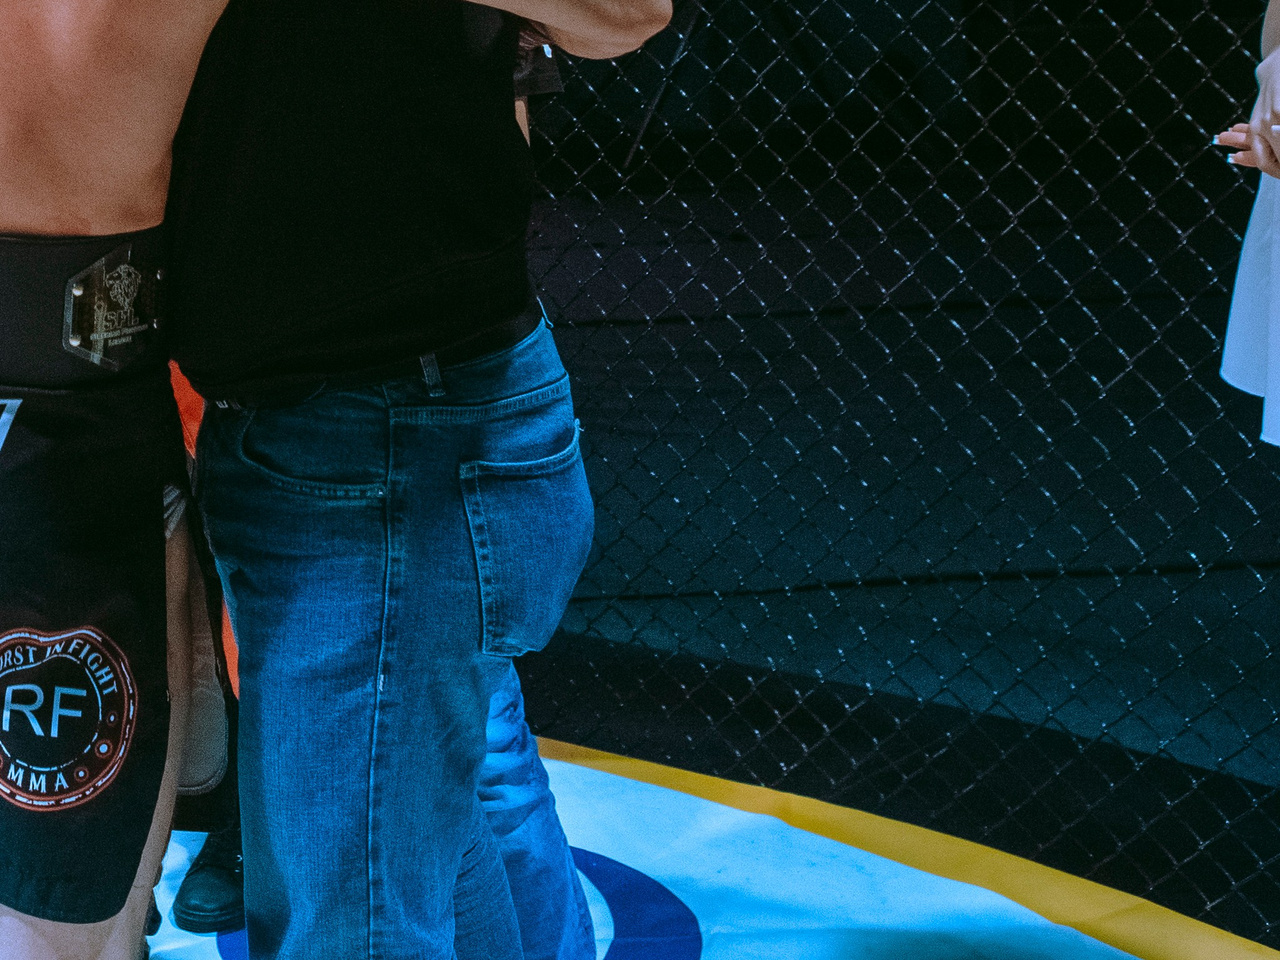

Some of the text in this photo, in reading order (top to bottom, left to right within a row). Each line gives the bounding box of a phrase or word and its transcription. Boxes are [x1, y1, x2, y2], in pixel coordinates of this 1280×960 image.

[46, 641, 65, 658] IN
[68, 639, 117, 695] FIGHT
[2, 683, 87, 738] RF
[7, 763, 69, 793] MMA
